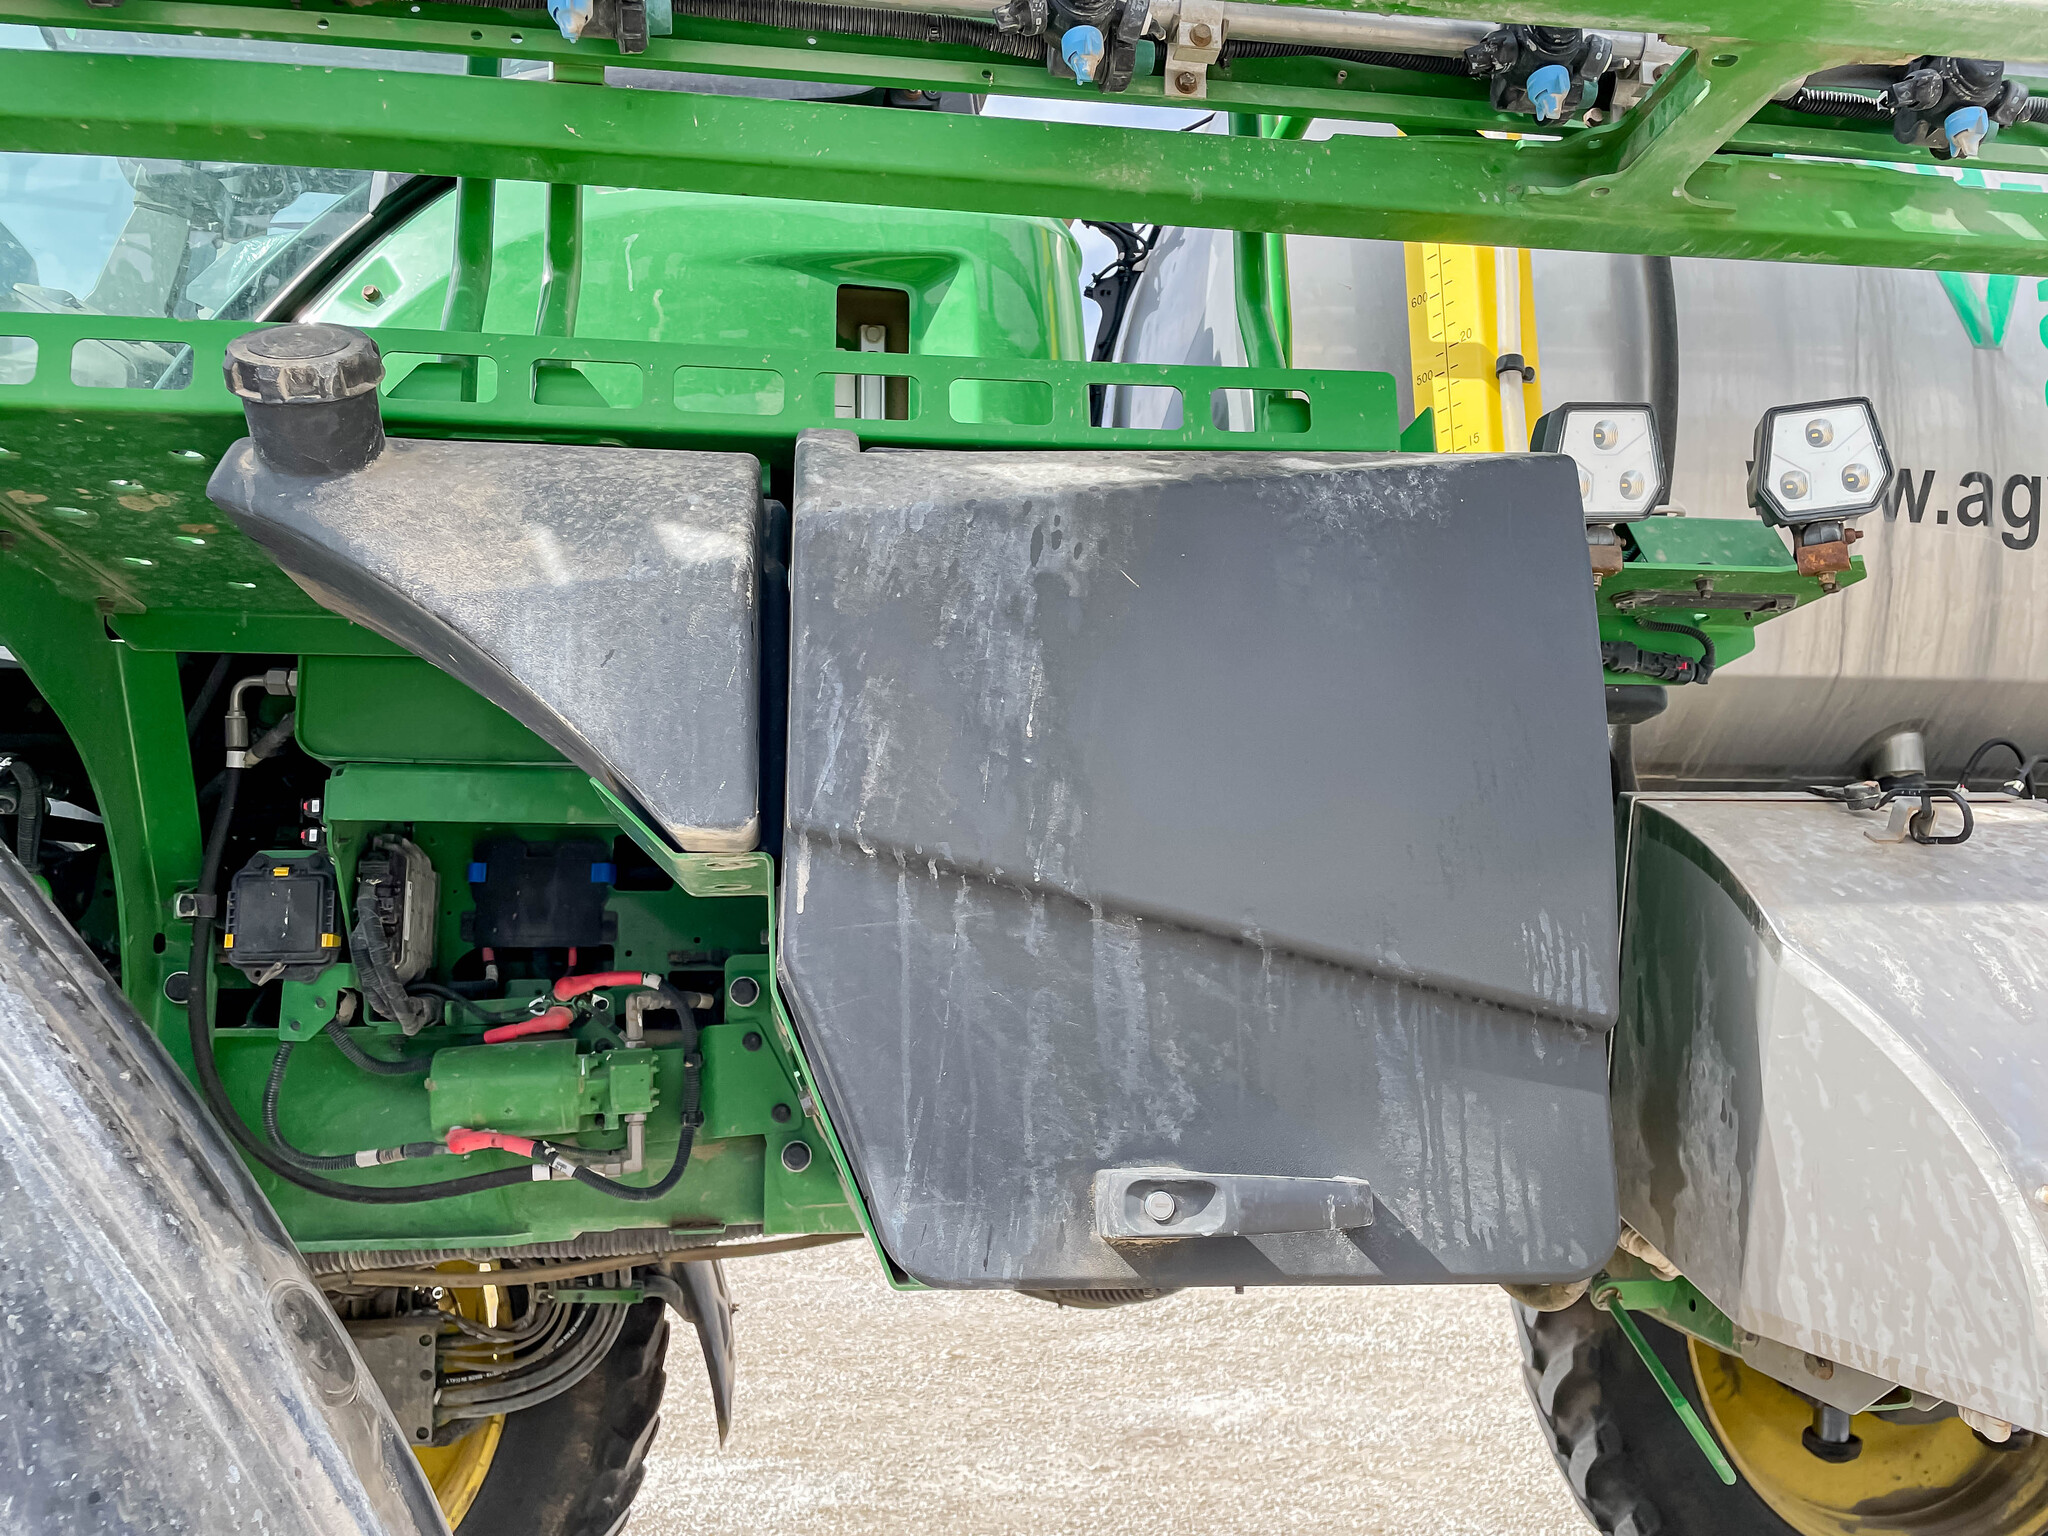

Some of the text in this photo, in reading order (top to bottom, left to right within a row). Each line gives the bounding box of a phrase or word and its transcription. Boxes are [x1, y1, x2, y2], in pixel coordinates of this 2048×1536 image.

[1411, 292, 1428, 308] 600
[1459, 328, 1472, 342] 20
[1416, 370, 1433, 386] 500
[1468, 432, 1480, 447] 15
[1880, 468, 2048, 551] w.ag
